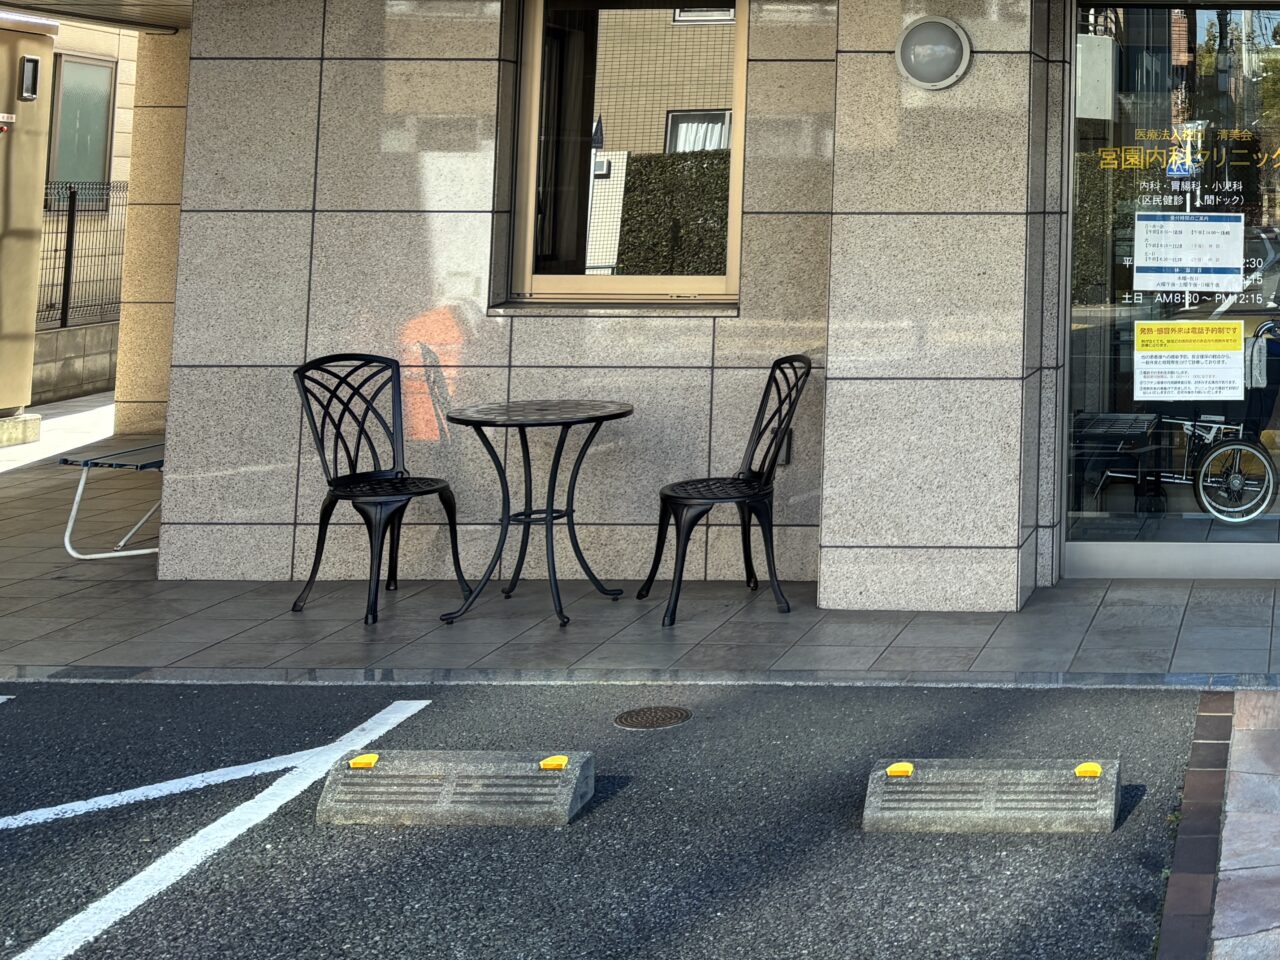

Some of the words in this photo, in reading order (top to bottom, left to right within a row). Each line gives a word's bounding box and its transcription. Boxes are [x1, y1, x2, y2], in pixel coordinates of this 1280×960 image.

[1139, 181, 1243, 192] 内科・胃腸科・小児科
[1122, 292, 1143, 303] 土日
